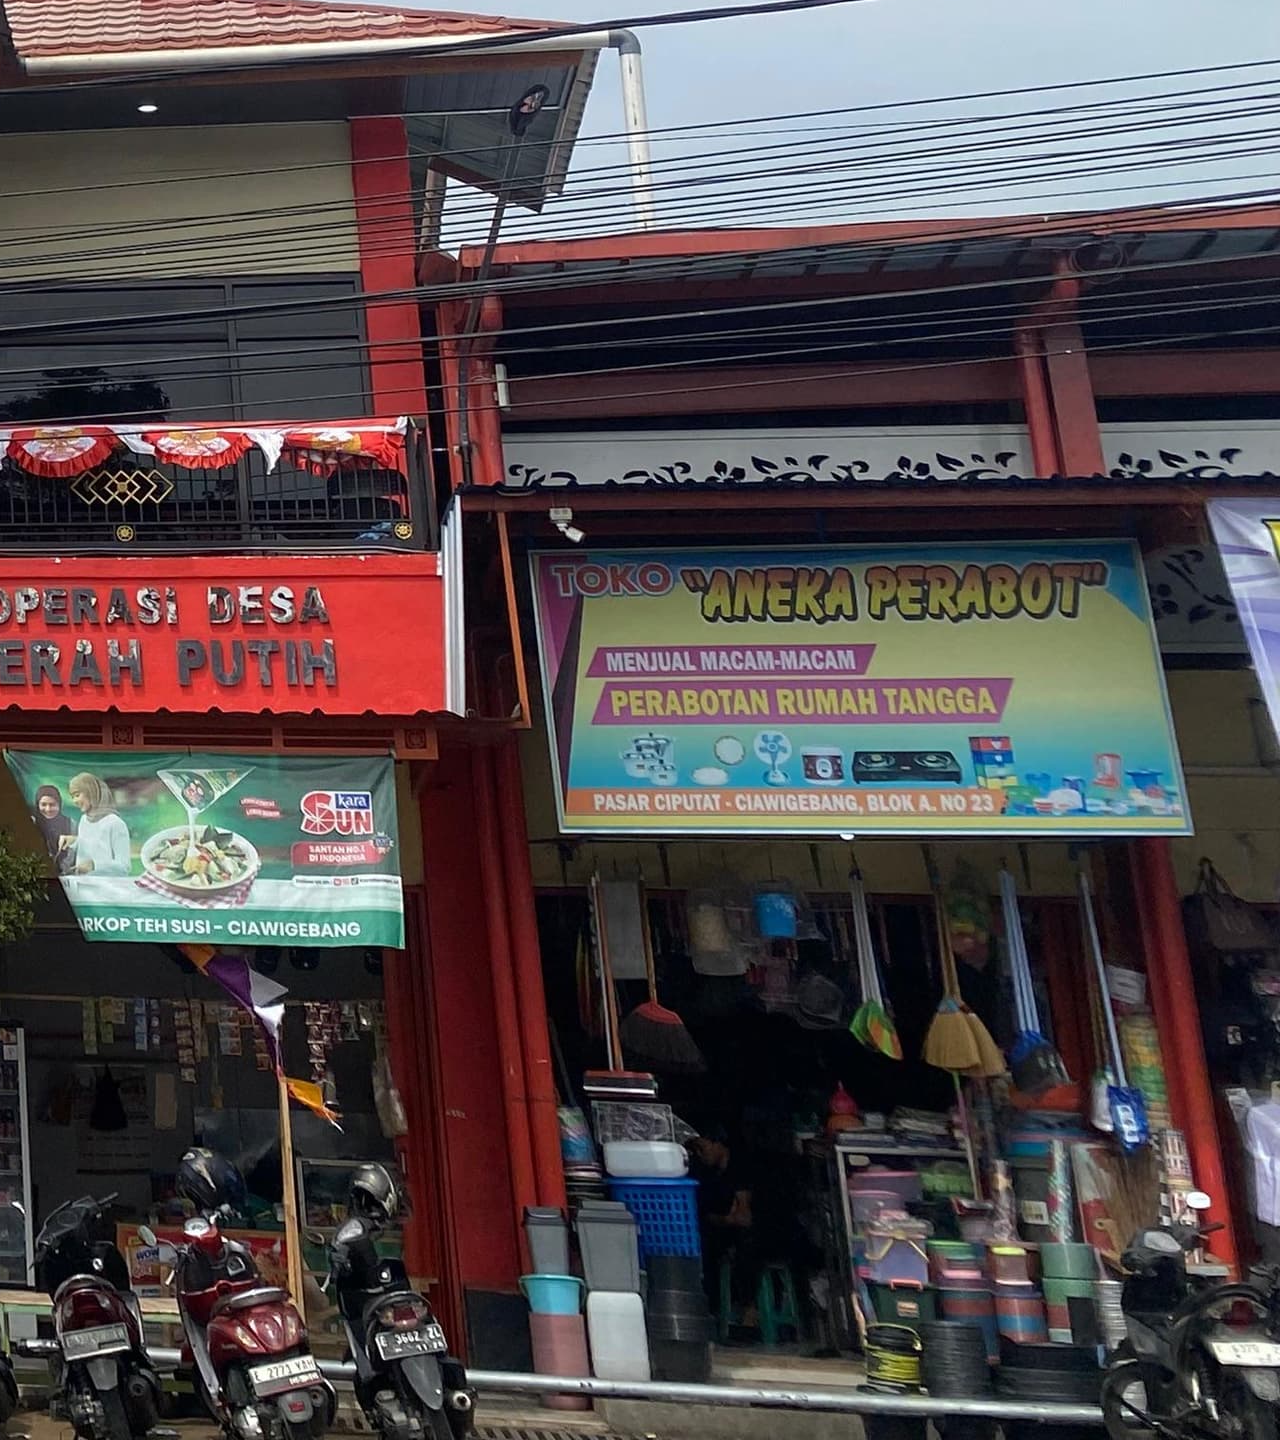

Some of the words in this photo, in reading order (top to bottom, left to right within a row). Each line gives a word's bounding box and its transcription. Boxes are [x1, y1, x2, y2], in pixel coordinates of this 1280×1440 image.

[552, 563, 672, 596] TOKO
[207, 586, 330, 624] DESA
[175, 639, 337, 687] PUTIH
[606, 649, 697, 673] MENJUAL
[701, 648, 856, 672] MACAM-MACAM
[611, 690, 770, 717] PERABOTAN
[776, 689, 878, 716] RUMAH
[883, 687, 997, 714] TANGGA
[300, 790, 374, 835] SUN
[339, 794, 368, 810] kara
[594, 793, 649, 812] PASAR
[654, 793, 721, 811] CIPUTAT
[736, 793, 863, 815] CIAWIGEBANG,
[868, 794, 915, 812] BLOK
[918, 794, 937, 812] A.
[940, 794, 966, 812] NO
[970, 793, 994, 811] 23
[134, 918, 168, 934] TEH
[171, 920, 211, 934] SUSI
[227, 921, 361, 938] CIAWIGEBANG
